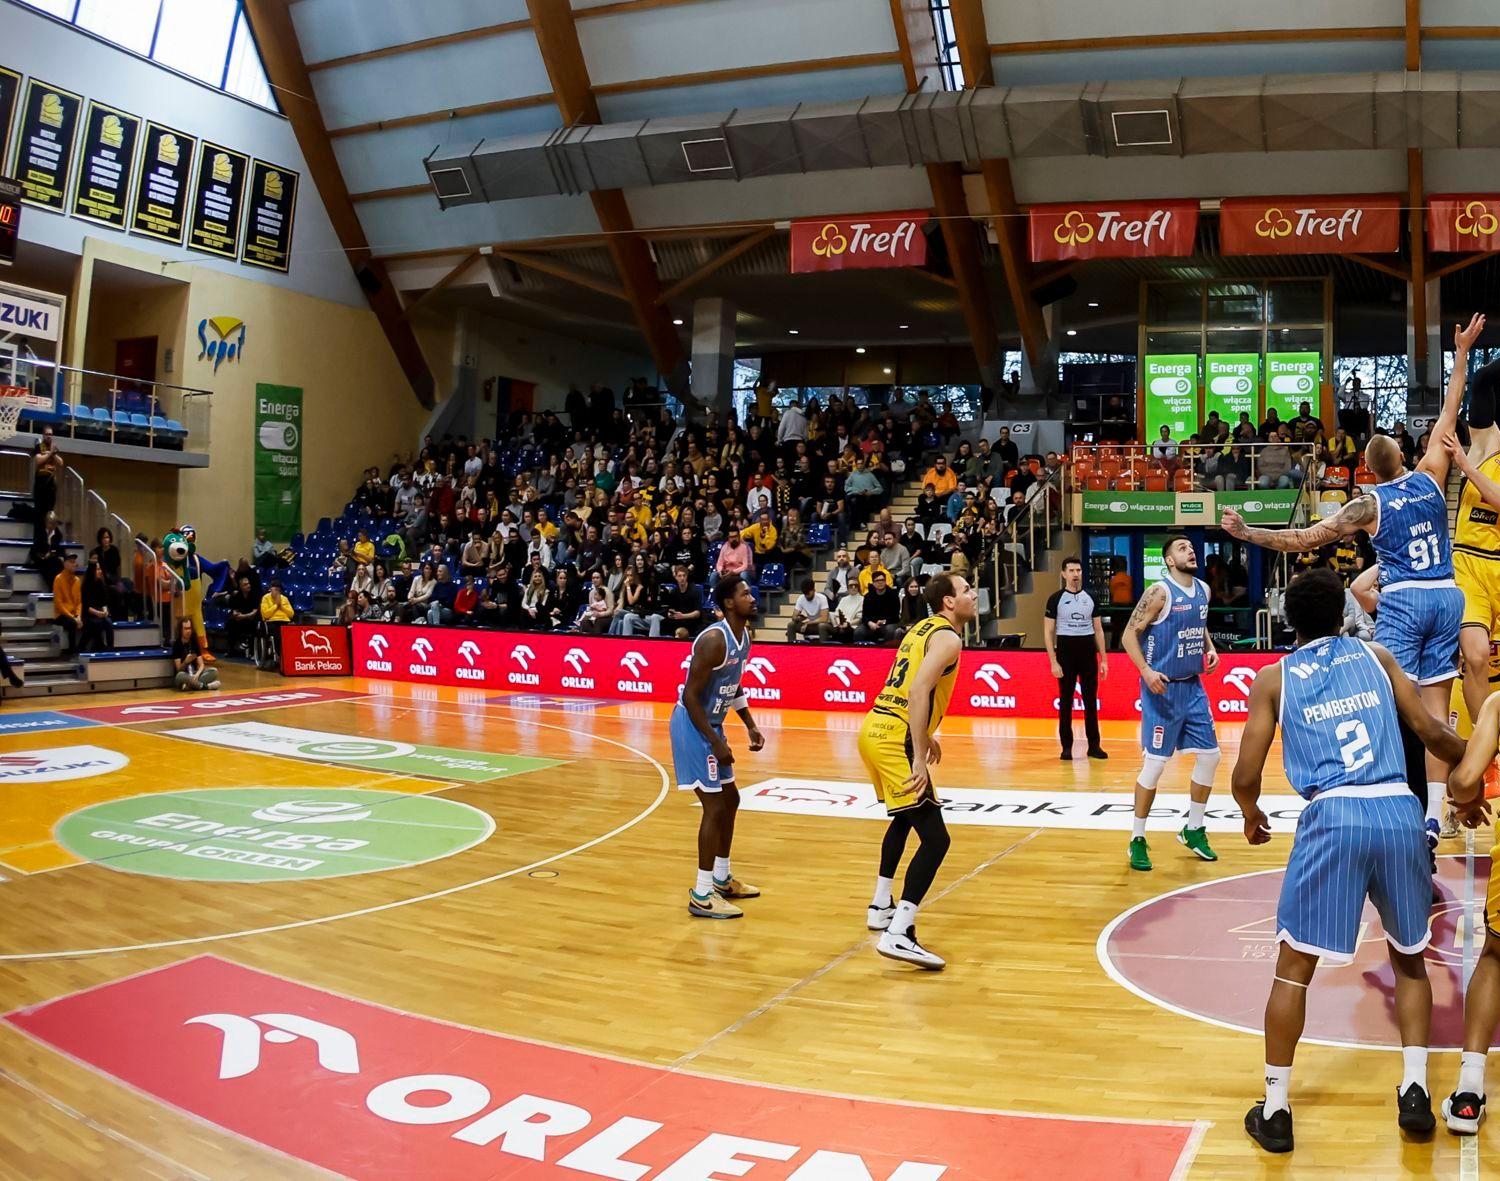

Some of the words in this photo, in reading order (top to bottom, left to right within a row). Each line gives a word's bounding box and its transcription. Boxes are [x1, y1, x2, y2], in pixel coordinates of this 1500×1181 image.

[1097, 210, 1172, 248] Trefl
[1295, 208, 1362, 246] Trefl
[849, 222, 915, 258] Trefl
[0, 302, 49, 331] ZUKI
[1150, 364, 1192, 376] Energa
[1210, 362, 1253, 375] Energa
[1271, 361, 1314, 374] Energa
[1163, 397, 1192, 406] włącza
[1224, 396, 1252, 405] włącza
[1285, 395, 1314, 404] włącza
[260, 398, 299, 420] Energa
[1171, 405, 1192, 413] sport
[1231, 404, 1252, 413] sport
[1292, 403, 1314, 412] spt
[1012, 424, 1030, 432] C3
[1084, 502, 1108, 510] Energa
[1156, 504, 1174, 512] sport
[1264, 502, 1290, 510] włącza
[1409, 521, 1432, 537] WYKA
[1408, 533, 1441, 571] 91
[1144, 555, 1165, 565] Ener
[1178, 627, 1204, 640] GÓRNI
[1186, 641, 1204, 649] ZAME
[295, 661, 316, 671] Bank
[318, 661, 343, 671] Pekao
[367, 660, 391, 671] ORLEN
[410, 664, 436, 676] ORLEN
[456, 668, 484, 680] ORLEN
[508, 672, 539, 685] ORLEN
[561, 676, 594, 689] ORLEN
[617, 680, 652, 693] ORLEN
[191, 692, 322, 709] ORLEN
[824, 689, 866, 703] ORLEN
[970, 695, 1016, 708] ORLEN
[1218, 699, 1249, 713] ORL
[1303, 690, 1381, 725] PEMBERTON
[1335, 719, 1374, 773] 2
[940, 798, 1075, 815] ank
[135, 813, 369, 851] Energa
[90, 830, 190, 852] GRUPA
[196, 847, 313, 870] ORLEN
